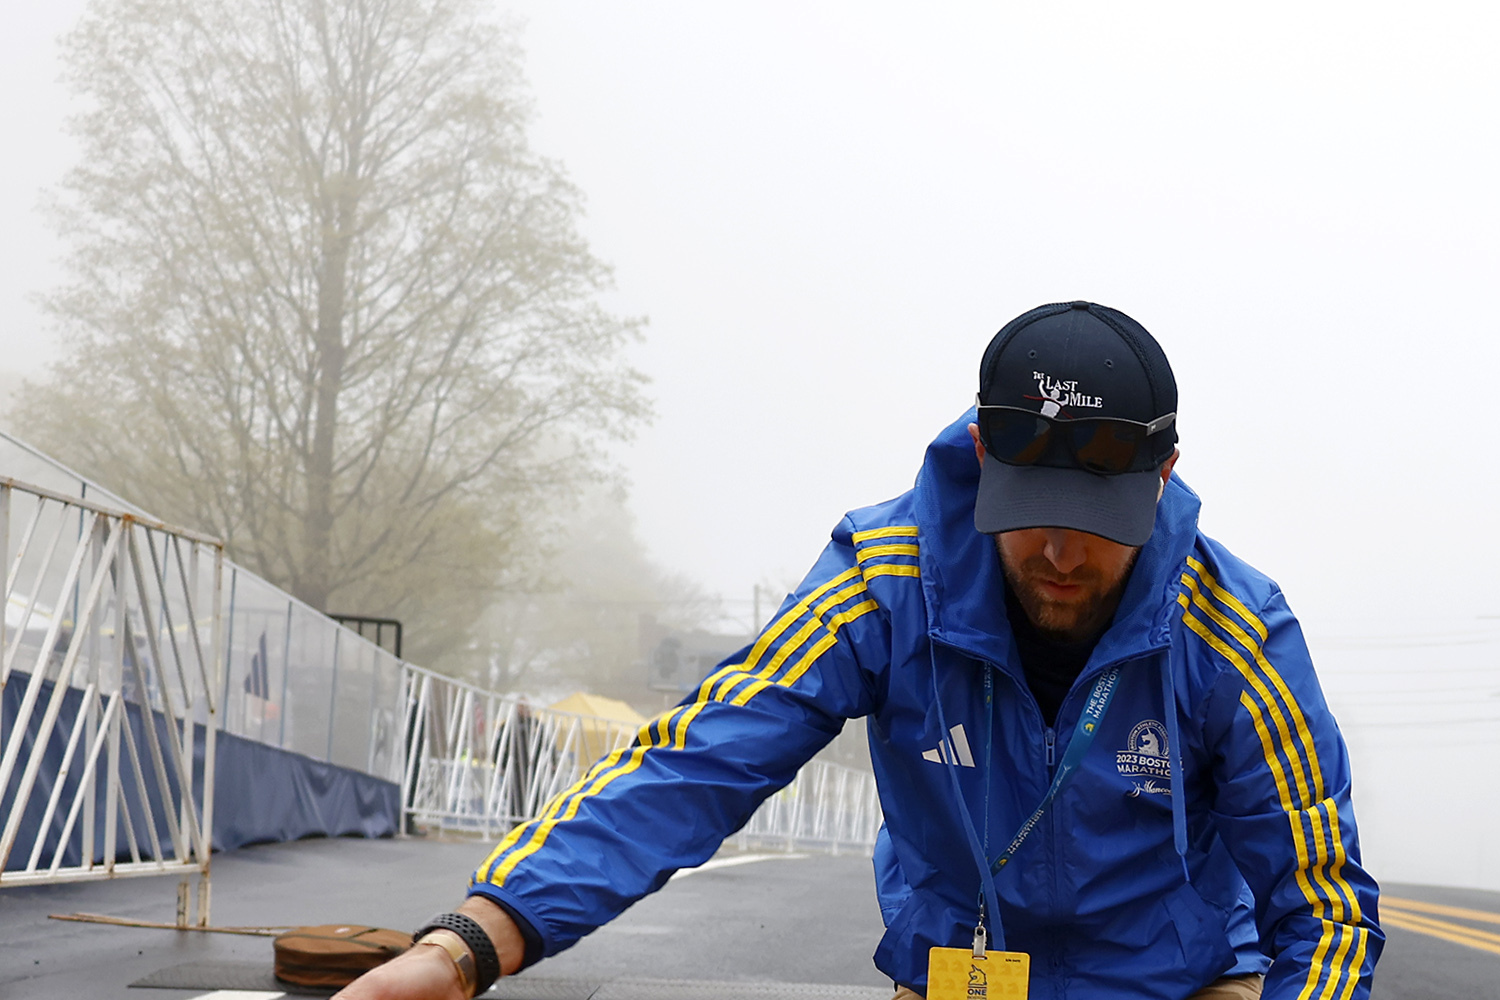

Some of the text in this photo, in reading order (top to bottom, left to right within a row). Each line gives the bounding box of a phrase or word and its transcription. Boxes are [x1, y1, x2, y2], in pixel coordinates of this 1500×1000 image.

[1046, 376, 1078, 392] LAST
[1069, 392, 1103, 408] MILE
[1086, 670, 1110, 714] THE BOSTO
[1092, 668, 1119, 719] MARATHON
[1116, 754, 1182, 768] 2023 BOSTO
[1117, 764, 1184, 777] MARATHO
[967, 988, 987, 996] ONE
